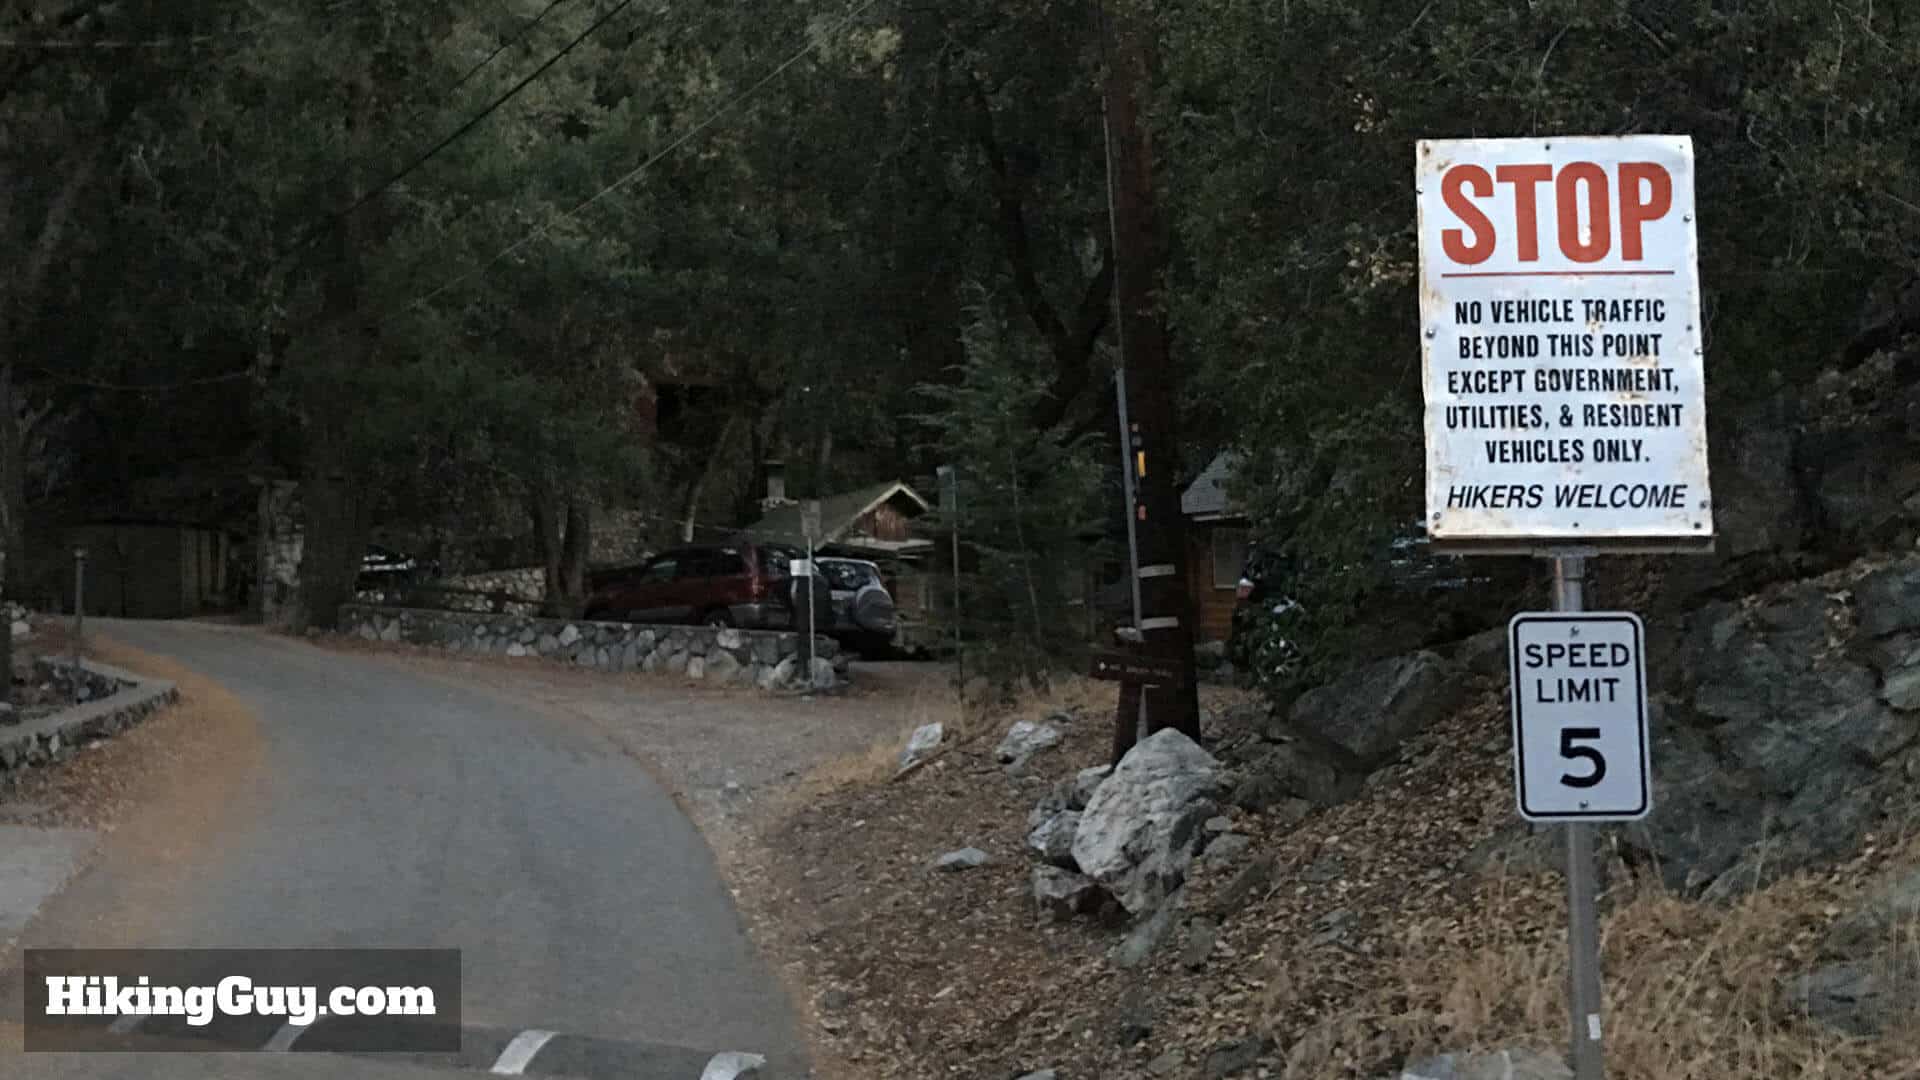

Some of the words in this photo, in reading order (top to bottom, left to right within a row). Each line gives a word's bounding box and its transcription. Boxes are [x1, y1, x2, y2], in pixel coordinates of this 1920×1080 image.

[1441, 161, 1673, 265] STOP
[1455, 301, 1482, 324] NO
[1491, 300, 1574, 323] VEHICLE
[1582, 299, 1666, 322] TRAFFIC
[1459, 335, 1539, 358] BEYOND
[1547, 334, 1594, 357] THIS
[1603, 334, 1662, 356] POINT
[1448, 370, 1526, 393] EXCEPT
[1534, 368, 1679, 393] GOVERNMENT,
[1446, 404, 1550, 429] UTILITIES,
[1559, 404, 1574, 427] &
[1583, 404, 1684, 427] RESIDENT
[1485, 440, 1584, 463] VEHICLES
[1593, 440, 1650, 462] ONLY.
[1447, 485, 1544, 509] HIKERS
[1555, 484, 1688, 509] WELCOME
[1525, 643, 1630, 668] SPEED
[1536, 678, 1620, 703] LIMIT
[1559, 728, 1606, 788] 5
